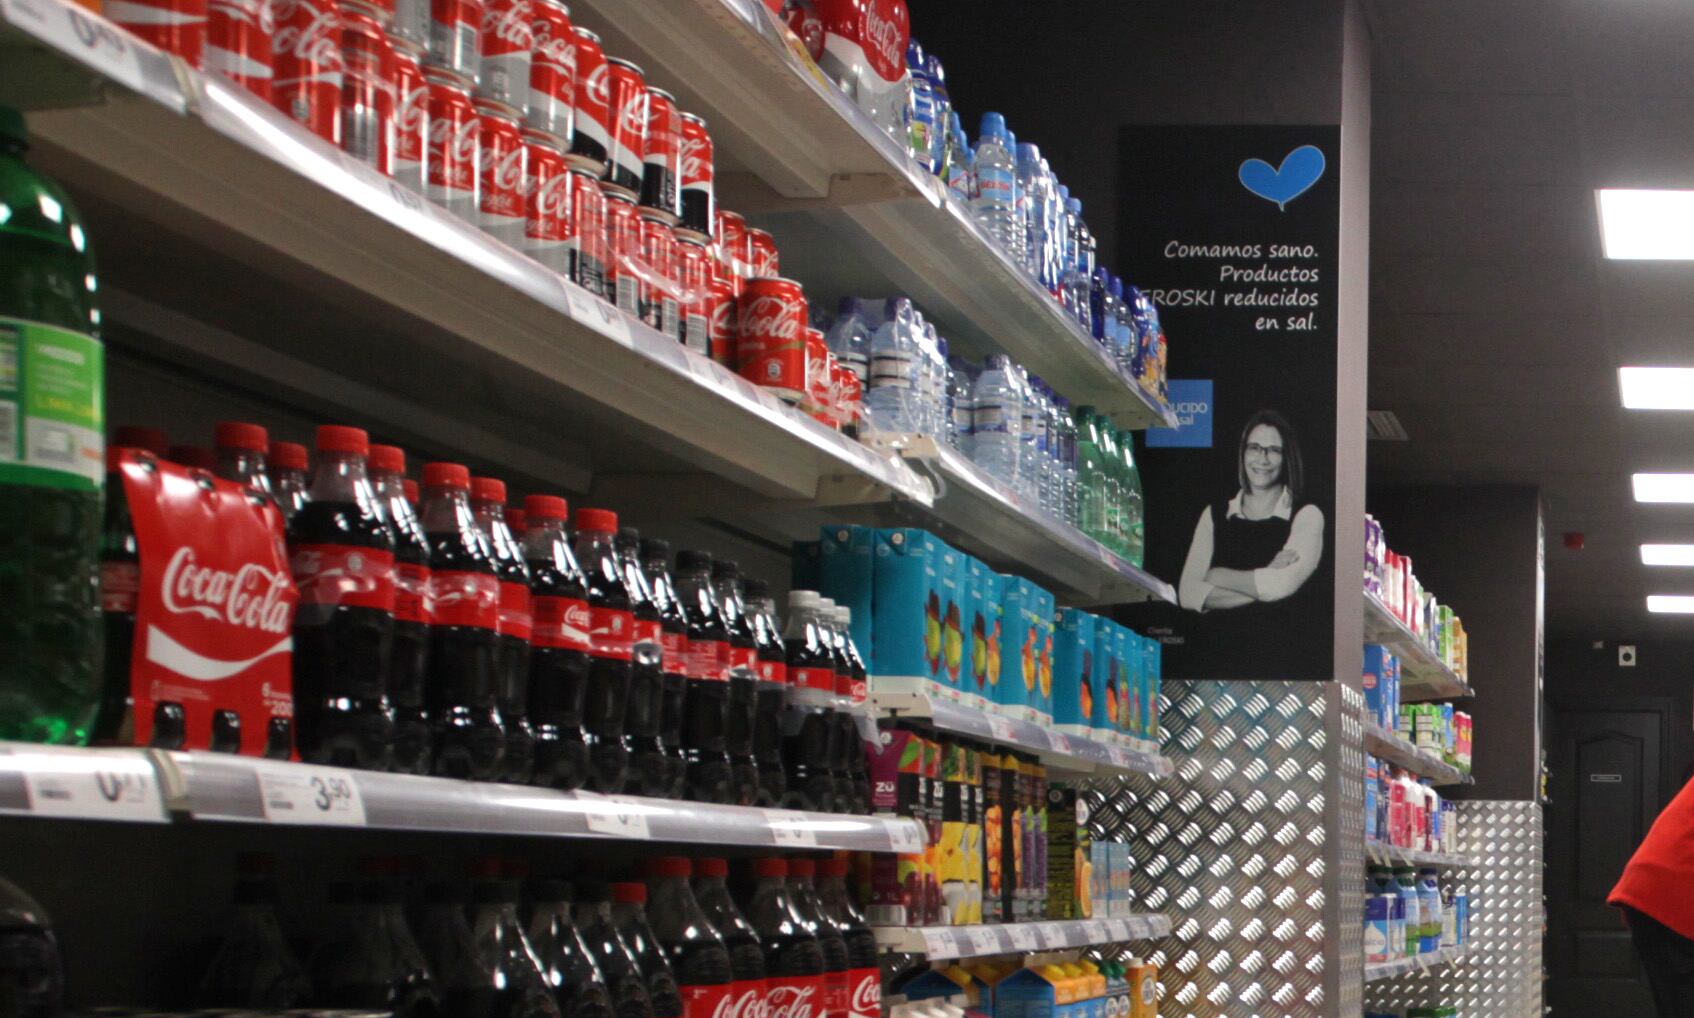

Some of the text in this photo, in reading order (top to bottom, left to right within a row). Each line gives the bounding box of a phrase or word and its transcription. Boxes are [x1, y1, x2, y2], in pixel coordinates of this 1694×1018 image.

[1164, 241, 1319, 258] Comamos sano.
[1219, 264, 1319, 282] Productos
[1223, 288, 1319, 306] reducidos
[1255, 312, 1318, 330] en sal.
[1165, 402, 1208, 414] DUCIDO
[162, 546, 292, 633] Coca-Cola
